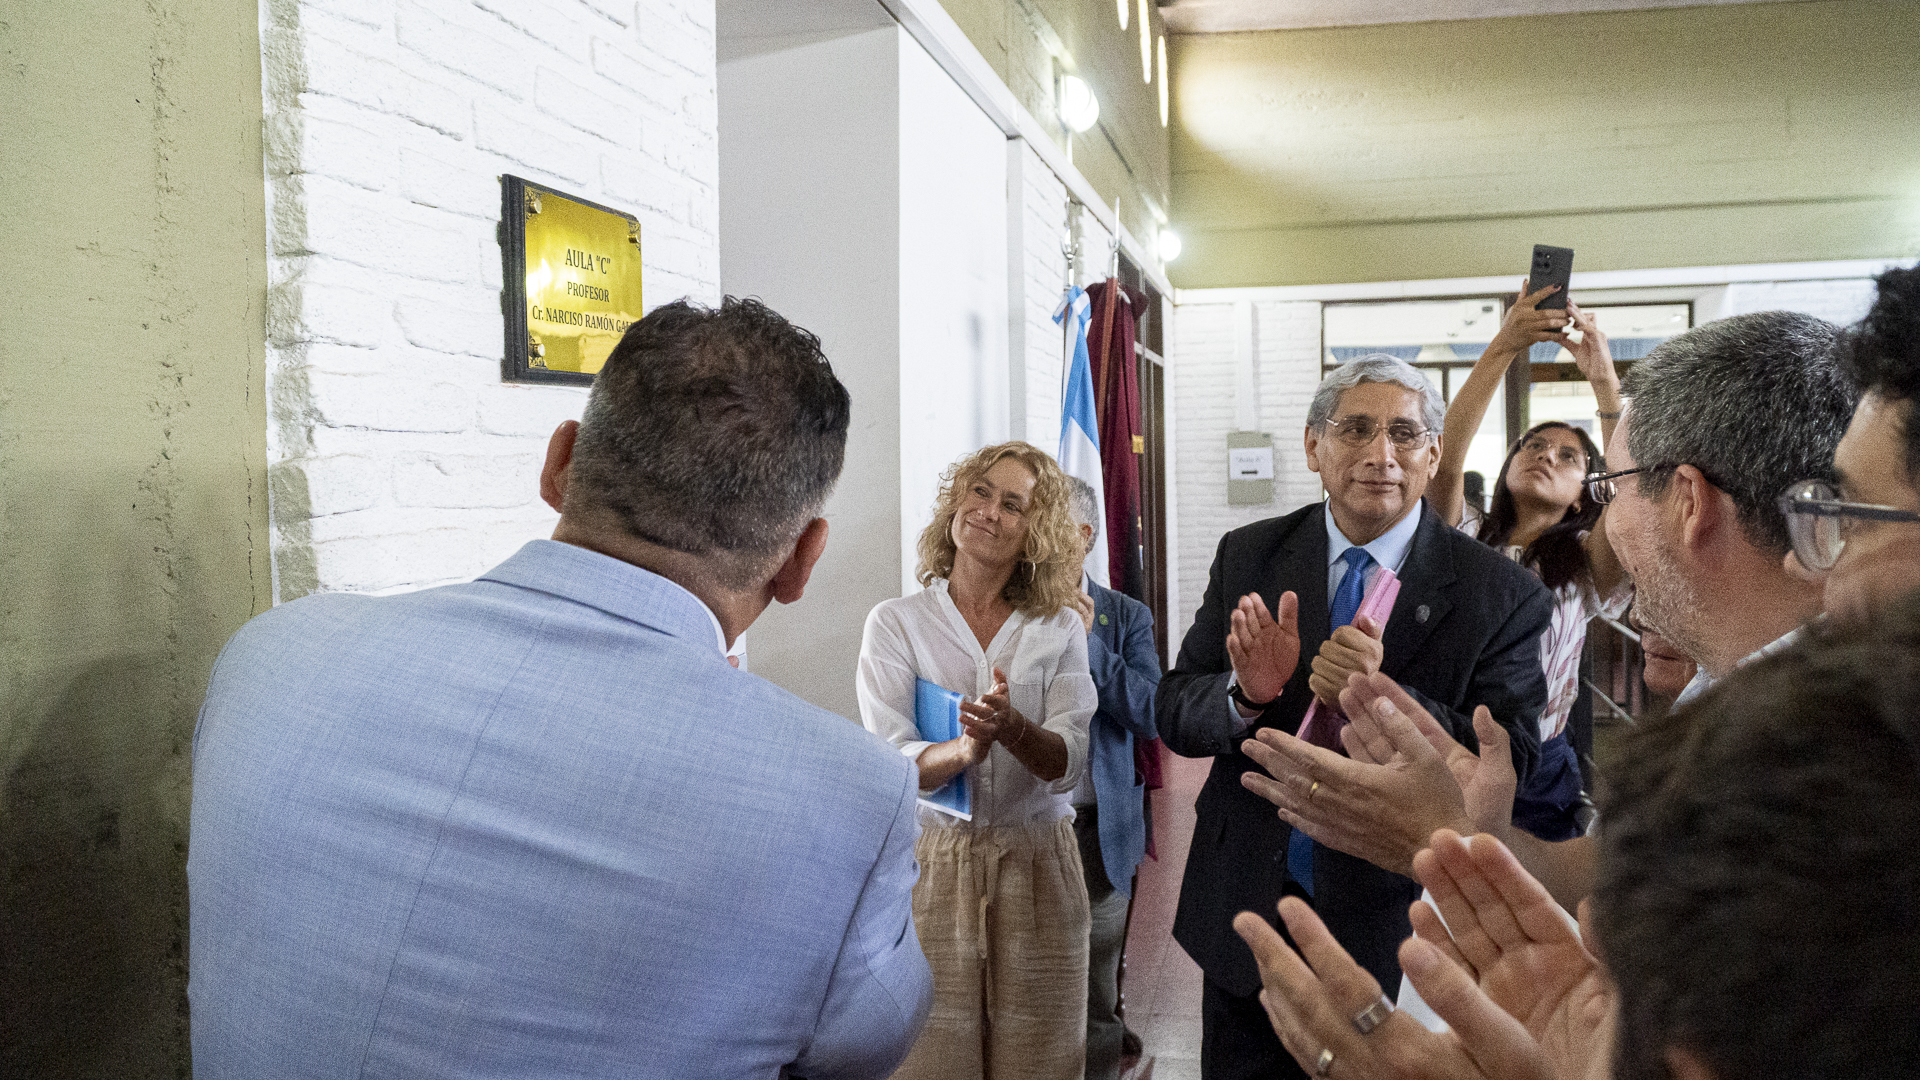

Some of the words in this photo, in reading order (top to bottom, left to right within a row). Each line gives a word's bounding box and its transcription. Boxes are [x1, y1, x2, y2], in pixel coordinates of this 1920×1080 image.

[565, 248, 594, 272] AULA
[567, 281, 610, 303] PROFESOR
[532, 305, 544, 321] Cr.
[546, 307, 583, 327] NARCISO
[585, 313, 614, 332] RAMÓN
